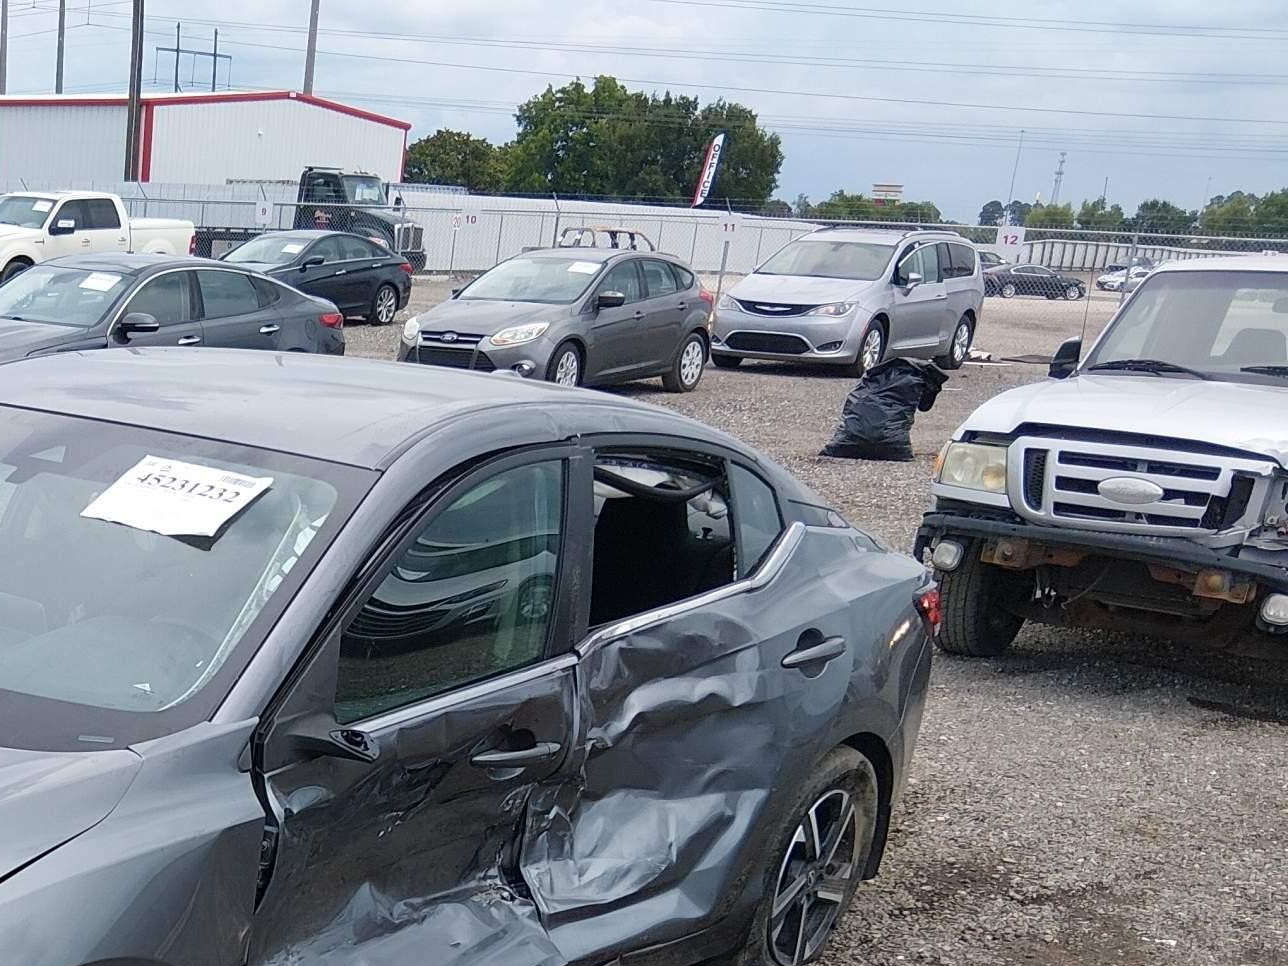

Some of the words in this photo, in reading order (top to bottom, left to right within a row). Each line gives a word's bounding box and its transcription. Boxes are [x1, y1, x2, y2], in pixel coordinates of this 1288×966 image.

[700, 143, 721, 198] OFFICE
[466, 215, 477, 224] 10
[724, 223, 735, 232] 11
[1003, 235, 1018, 245] 12
[136, 473, 241, 503] 45231232
